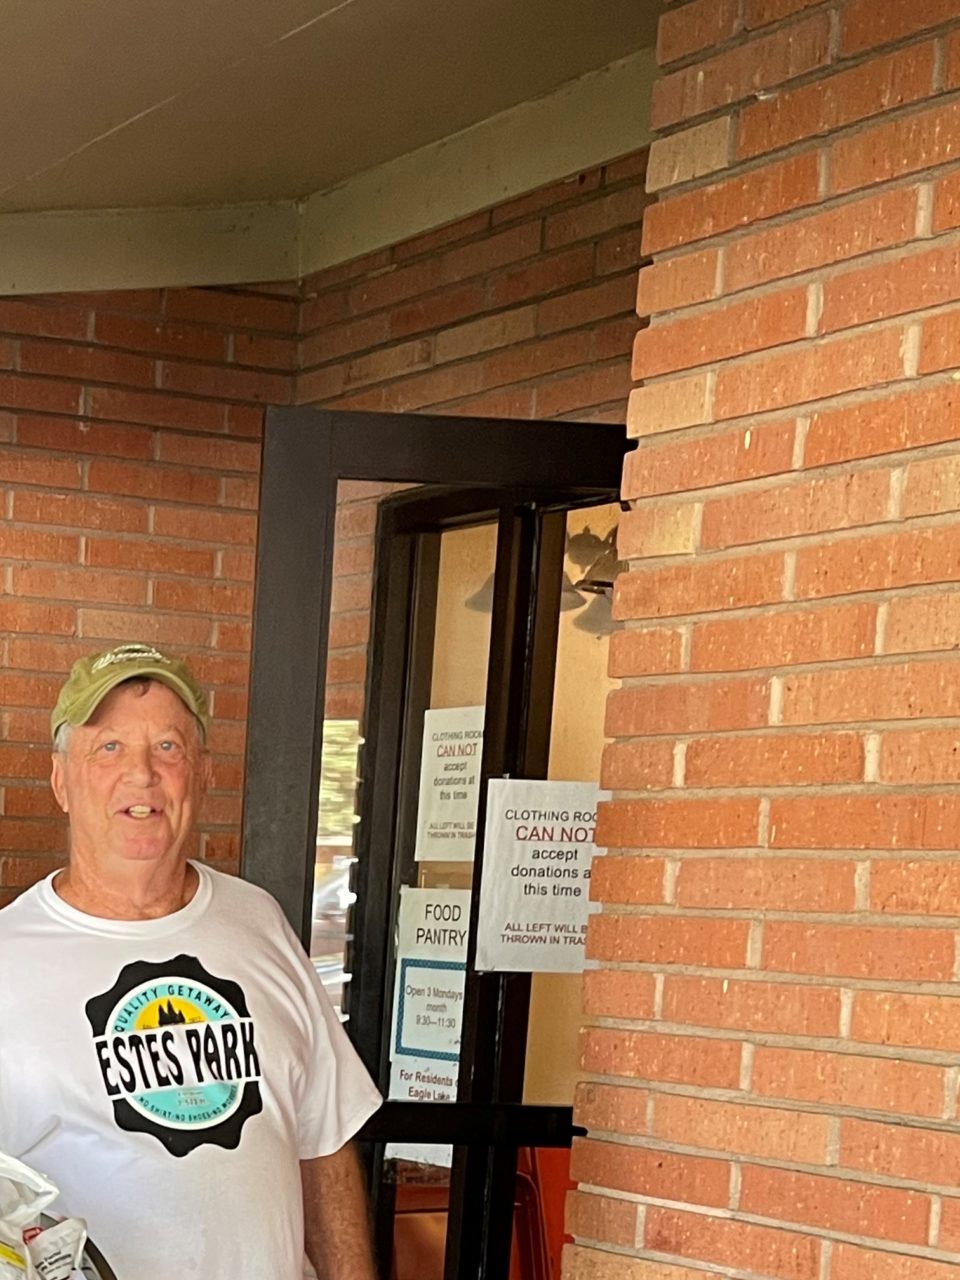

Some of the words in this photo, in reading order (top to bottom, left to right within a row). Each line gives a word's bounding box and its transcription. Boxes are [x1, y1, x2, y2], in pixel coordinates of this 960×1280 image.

[432, 732, 463, 742] CLOTHING
[437, 744, 455, 758] CAN
[458, 742, 478, 757] NOT
[444, 762, 467, 773] accept
[434, 776, 466, 787] donations
[468, 776, 475, 785] at
[440, 790, 451, 800] this
[453, 790, 467, 800] time
[505, 809, 570, 822] CLOTHING
[516, 825, 554, 842] CAN
[532, 848, 579, 863] accept
[511, 864, 579, 879] donations
[524, 883, 548, 896] this
[552, 884, 582, 897] time
[424, 904, 461, 922] FOOD
[505, 923, 523, 932] ALL
[526, 923, 552, 933] LEFT
[554, 924, 578, 934] WILL
[416, 928, 467, 947] PANTRY
[501, 934, 547, 945] THROWN
[549, 936, 560, 945] IN
[406, 985, 426, 999] Open
[427, 987, 432, 998] 3
[433, 987, 463, 1003] Mondays
[114, 988, 158, 1033] QUALITY
[167, 984, 230, 1019] GETAWAY
[95, 1030, 185, 1096] ESTES
[185, 1021, 262, 1084] PARK
[400, 1069, 413, 1081] For
[415, 1071, 453, 1087] Residents
[409, 1086, 432, 1101] Eagle
